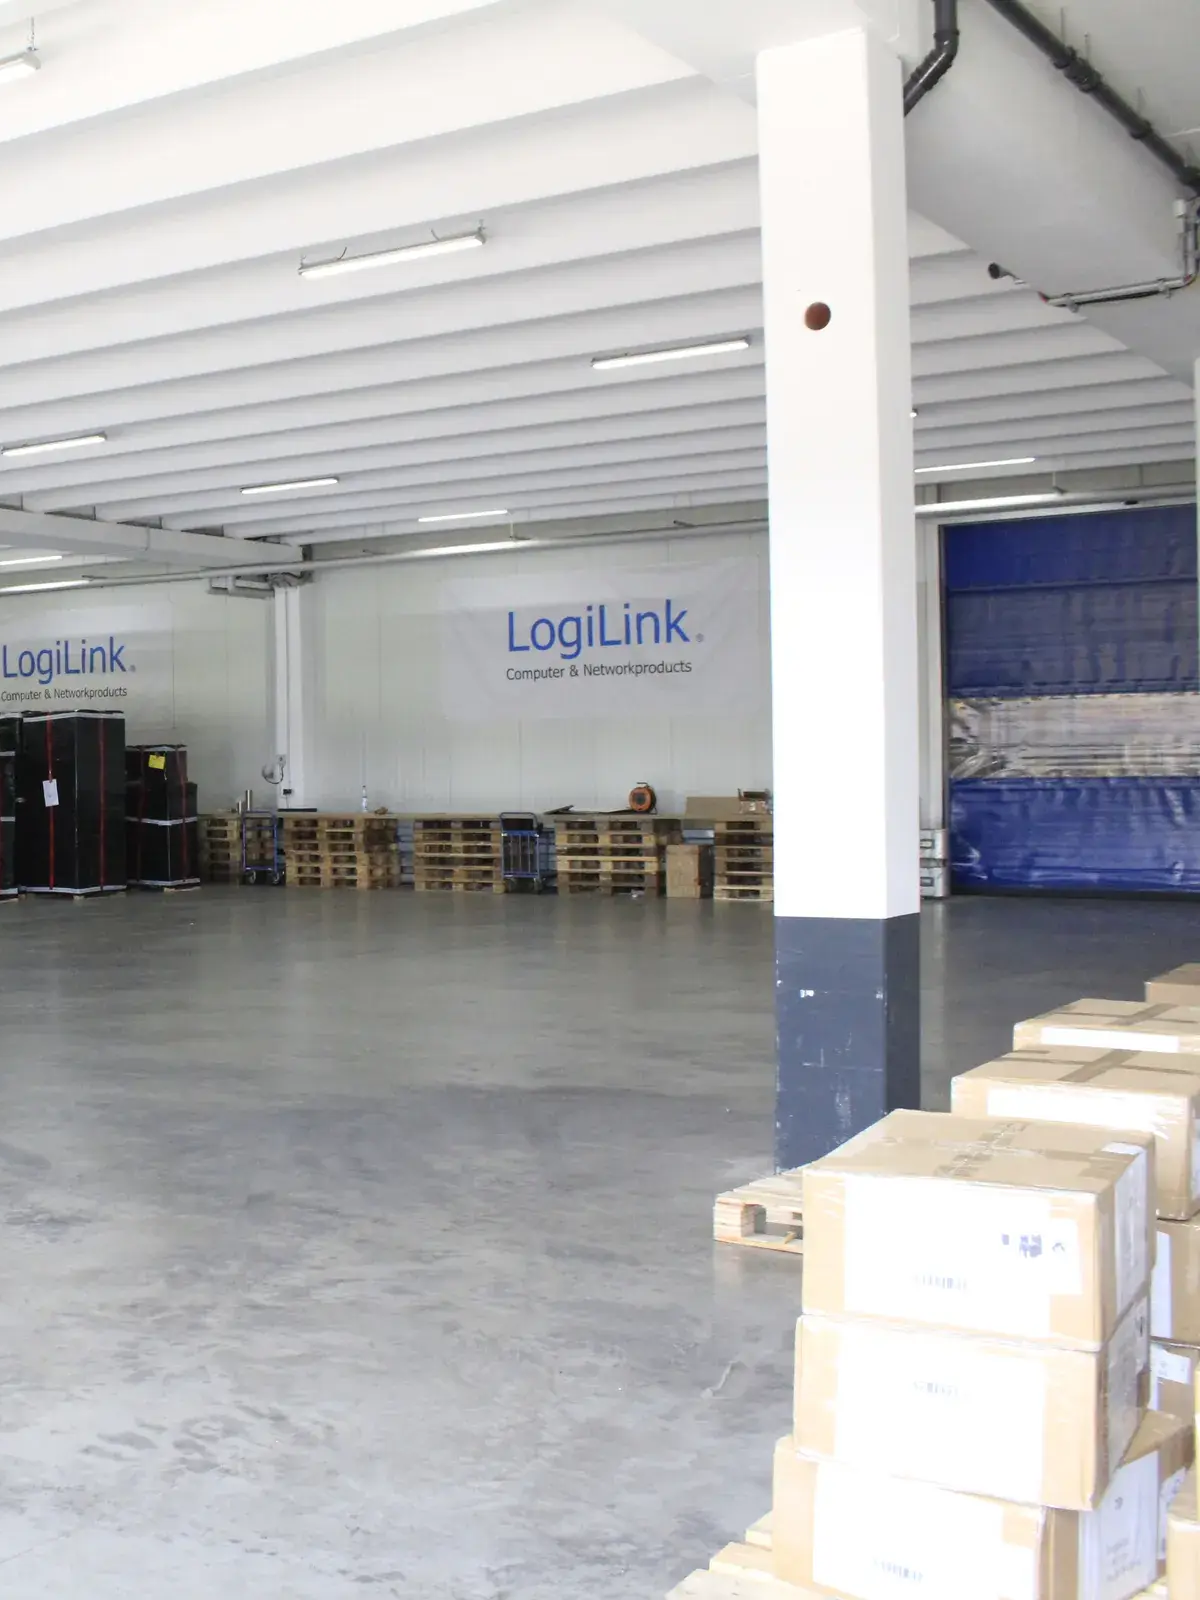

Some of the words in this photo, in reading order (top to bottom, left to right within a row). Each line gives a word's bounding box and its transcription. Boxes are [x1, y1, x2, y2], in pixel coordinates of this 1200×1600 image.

[506, 665, 565, 682] Computer
[569, 664, 579, 677] &
[583, 660, 693, 678] Networkproducts
[1, 689, 42, 702] Computer
[44, 689, 51, 699] &
[54, 686, 128, 700] Networkproducts
